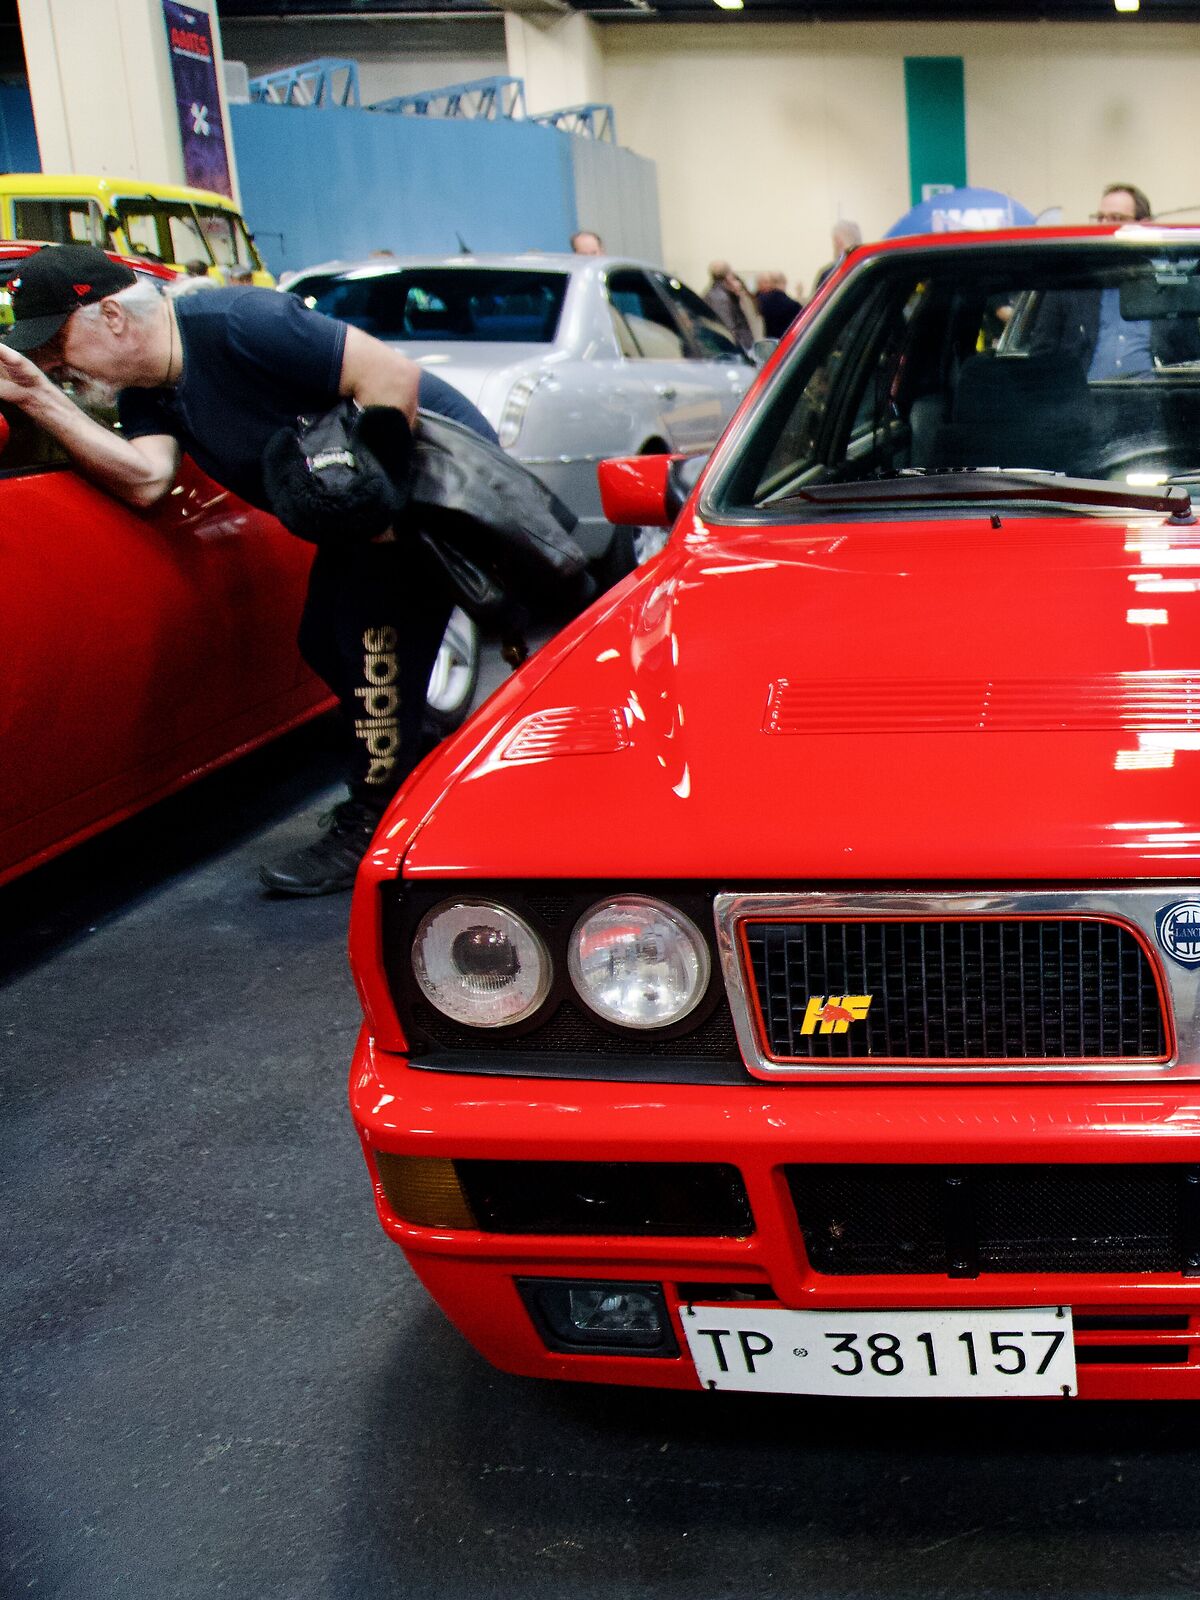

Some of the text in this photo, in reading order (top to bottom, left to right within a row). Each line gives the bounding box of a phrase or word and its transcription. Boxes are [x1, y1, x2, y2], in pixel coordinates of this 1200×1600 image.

[354, 625, 399, 785] adidas
[800, 994, 873, 1035] HF
[698, 1329, 1065, 1377] TP 381157
